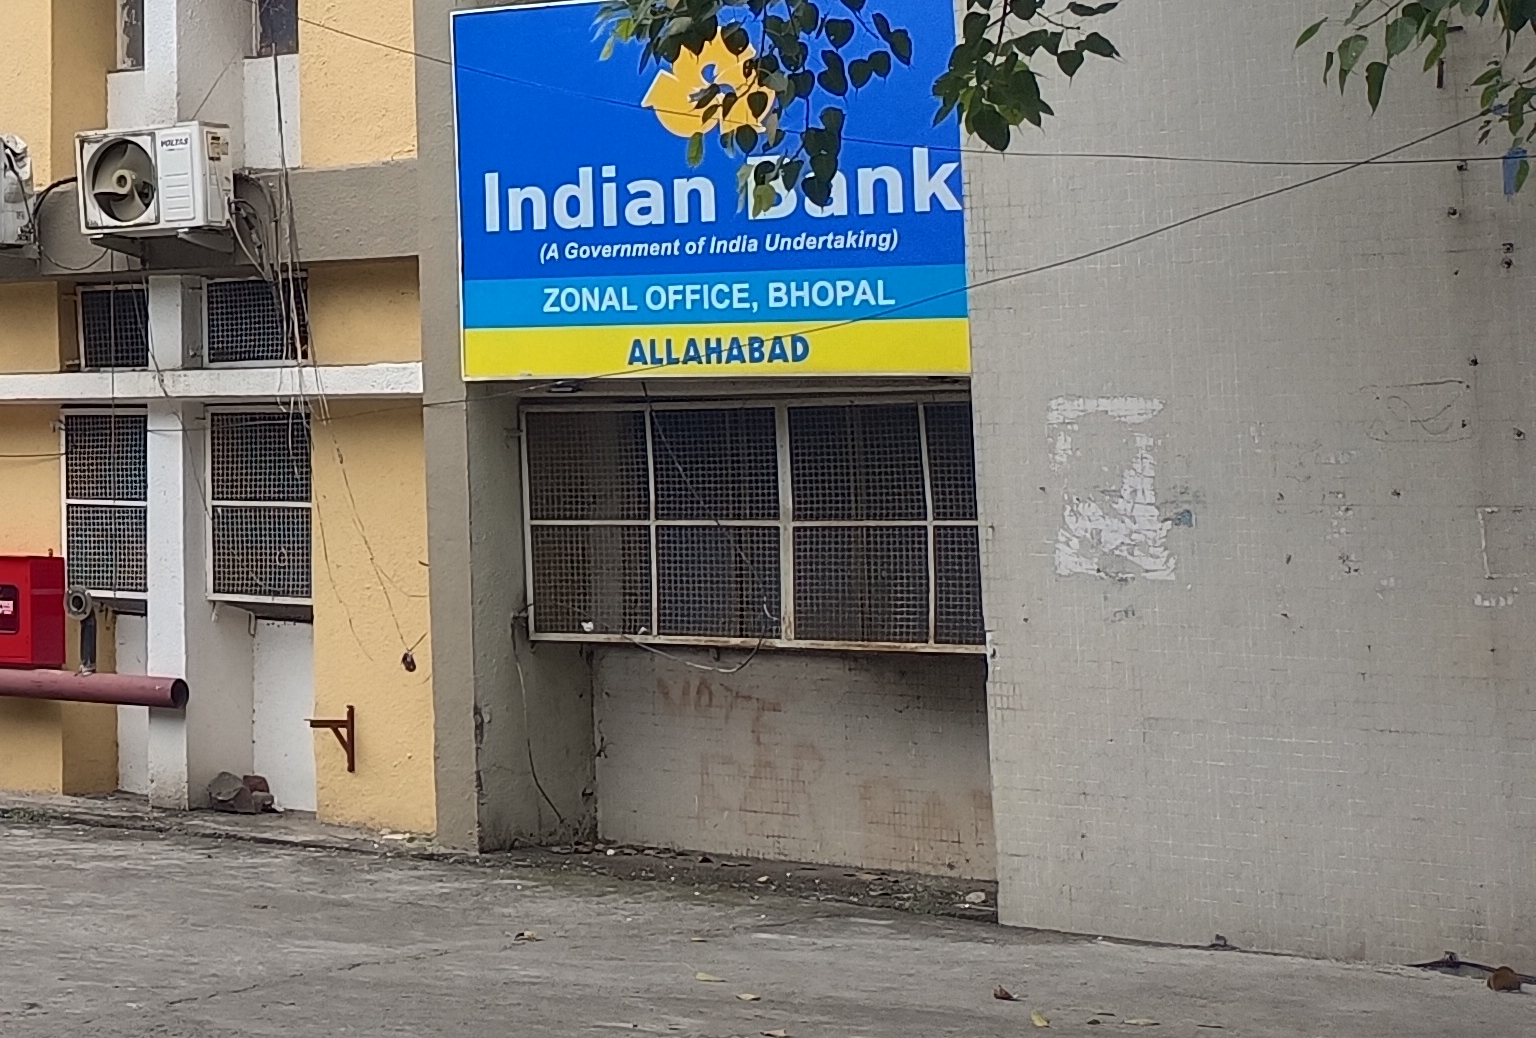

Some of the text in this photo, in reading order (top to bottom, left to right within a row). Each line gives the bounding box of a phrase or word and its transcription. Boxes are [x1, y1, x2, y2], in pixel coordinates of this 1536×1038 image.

[484, 146, 963, 233] Indian Bank
[539, 228, 899, 264] (A Government of India Undertaking)
[543, 280, 896, 313] ZONAL OFFICE, BHOPAL
[628, 335, 810, 366] ALLAHABAD
